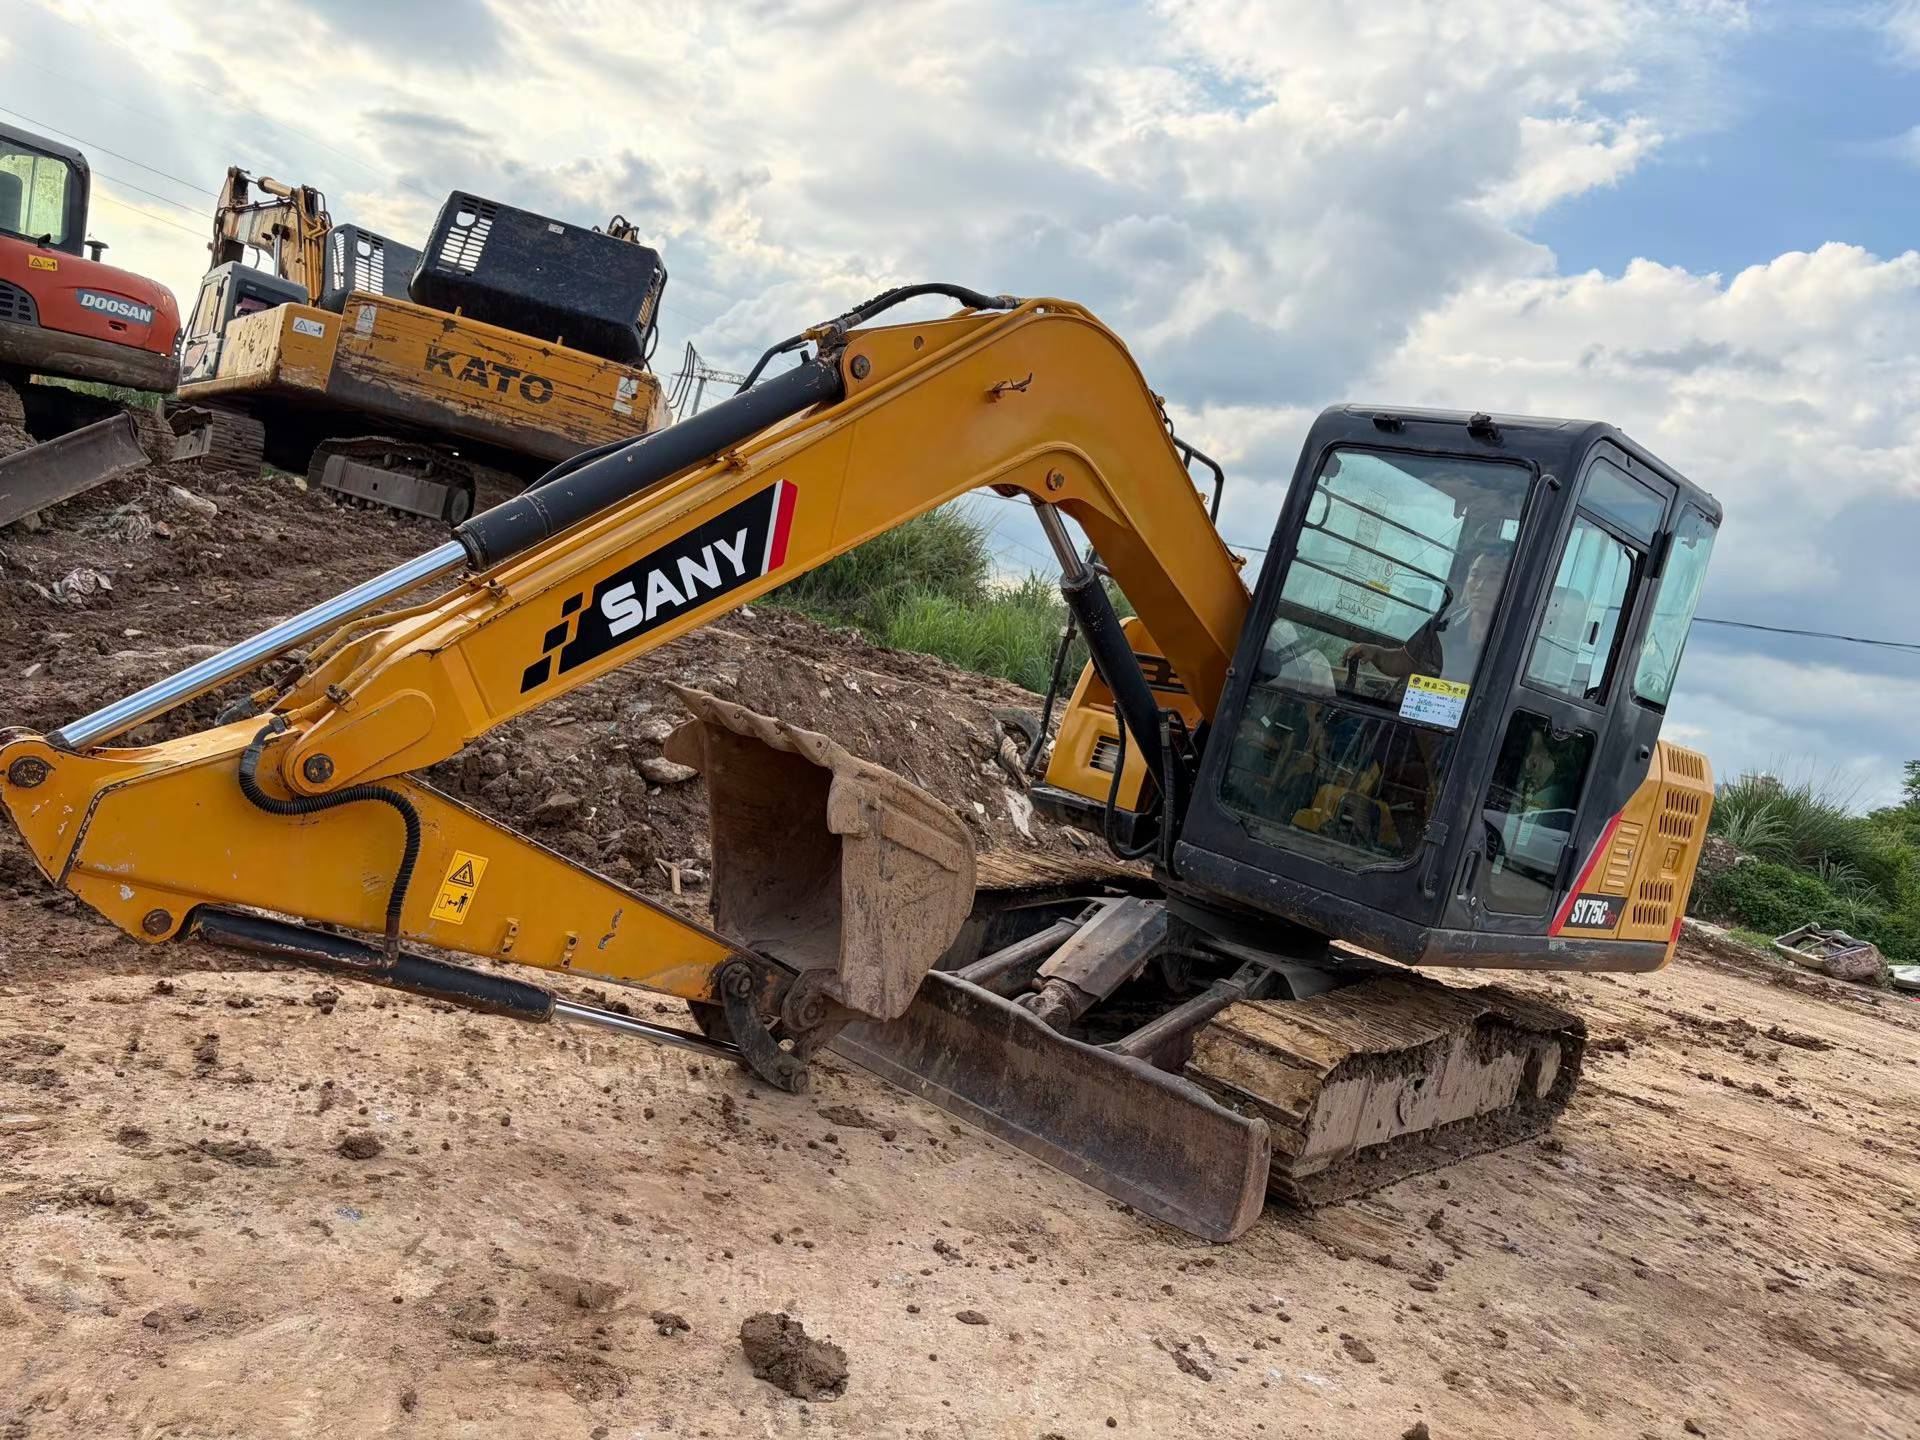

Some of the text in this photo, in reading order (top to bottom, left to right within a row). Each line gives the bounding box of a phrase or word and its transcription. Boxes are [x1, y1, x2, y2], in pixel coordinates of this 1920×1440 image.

[81, 294, 151, 322] DOOSAN
[424, 345, 554, 404] KATO
[601, 528, 748, 637] SANY
[1571, 899, 1609, 925] SY75C
